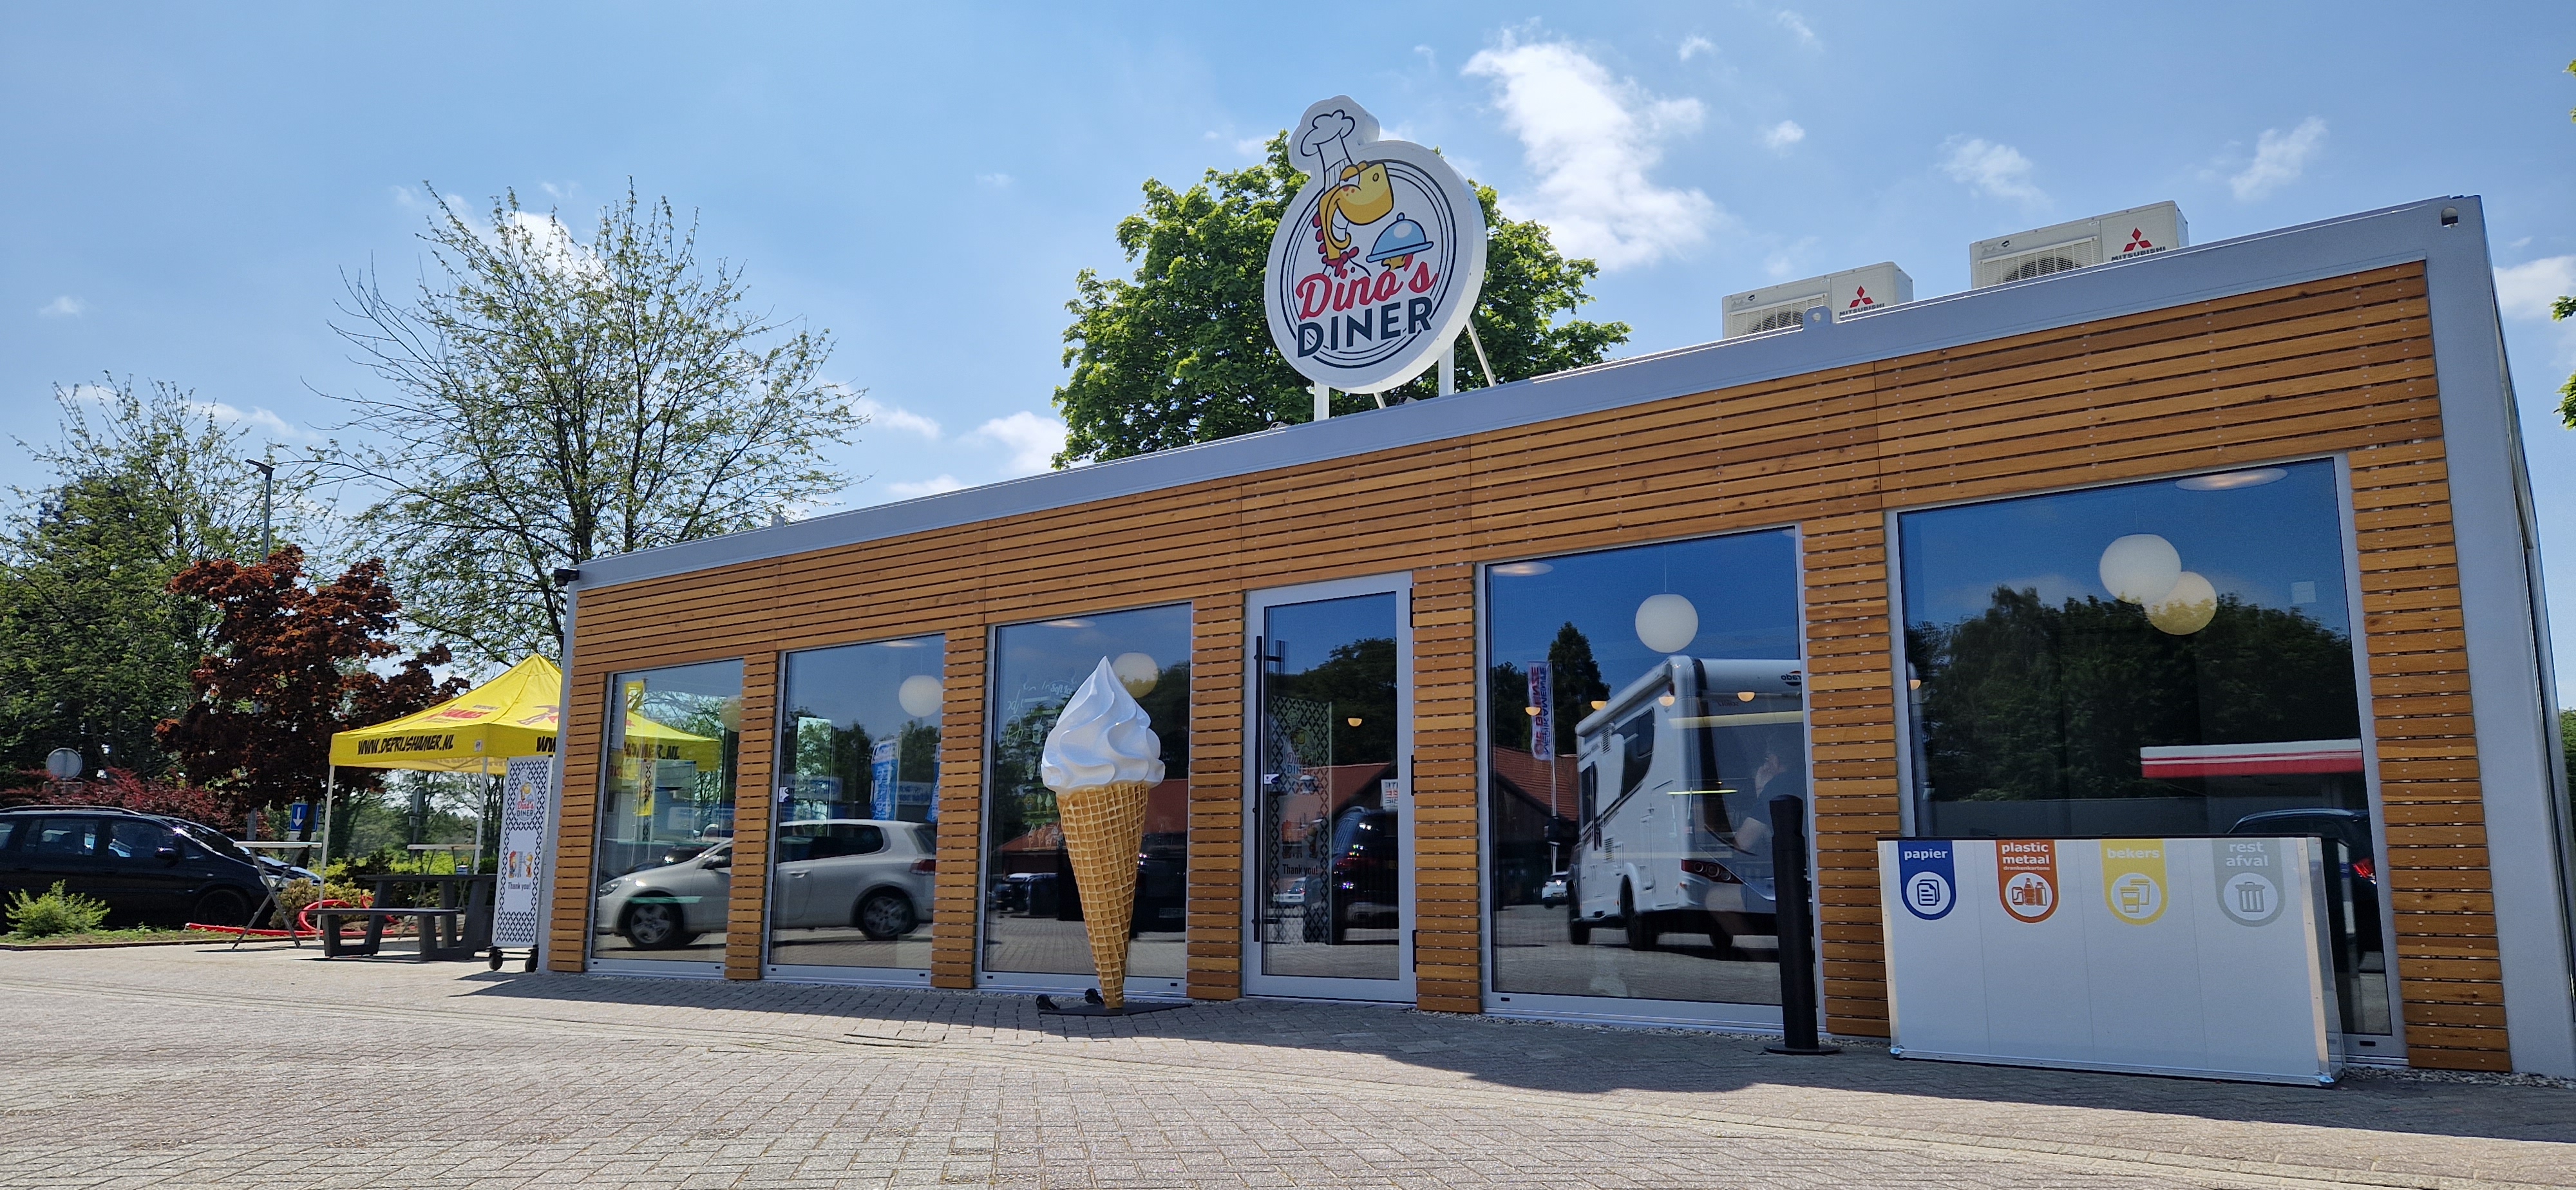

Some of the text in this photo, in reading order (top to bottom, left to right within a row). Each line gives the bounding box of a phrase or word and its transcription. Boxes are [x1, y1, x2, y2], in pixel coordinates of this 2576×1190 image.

[2111, 246, 2166, 261] MITSUBISHI
[1295, 254, 1439, 320] Dino's
[1839, 303, 1885, 317] MITSUBISHI
[1297, 296, 1433, 358] DINER
[516, 808, 533, 817] DINER
[2001, 842, 2049, 855] plastic
[2107, 848, 2160, 858] bekers
[2229, 842, 2264, 853] rest
[1904, 848, 1948, 861] papier
[2002, 854, 2050, 864] metaal
[2226, 855, 2269, 867] afval
[1282, 864, 1318, 876] Thank you!
[521, 882, 531, 891] you!
